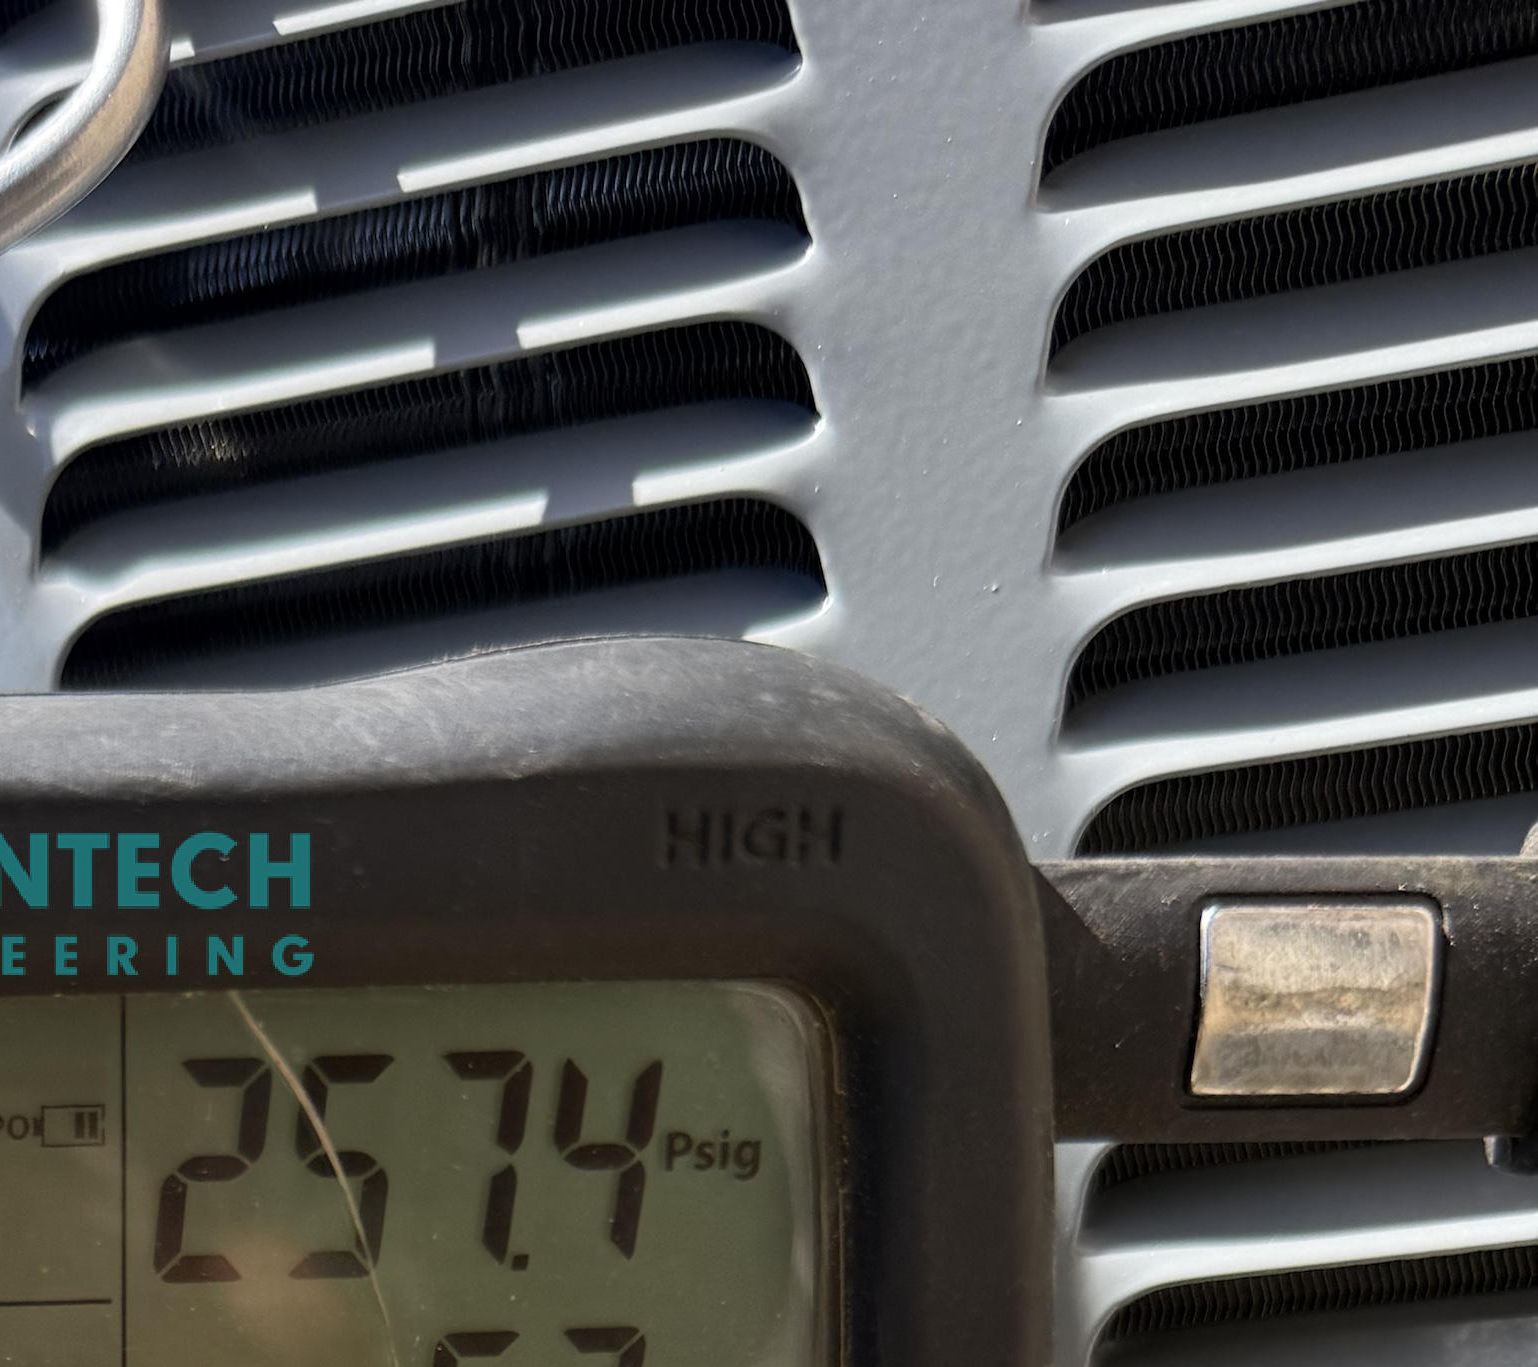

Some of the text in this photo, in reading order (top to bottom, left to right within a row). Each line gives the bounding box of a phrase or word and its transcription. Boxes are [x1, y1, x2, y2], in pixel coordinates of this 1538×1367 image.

[665, 807, 844, 866] HIGH
[153, 1050, 761, 1284] 257.4 Psig
